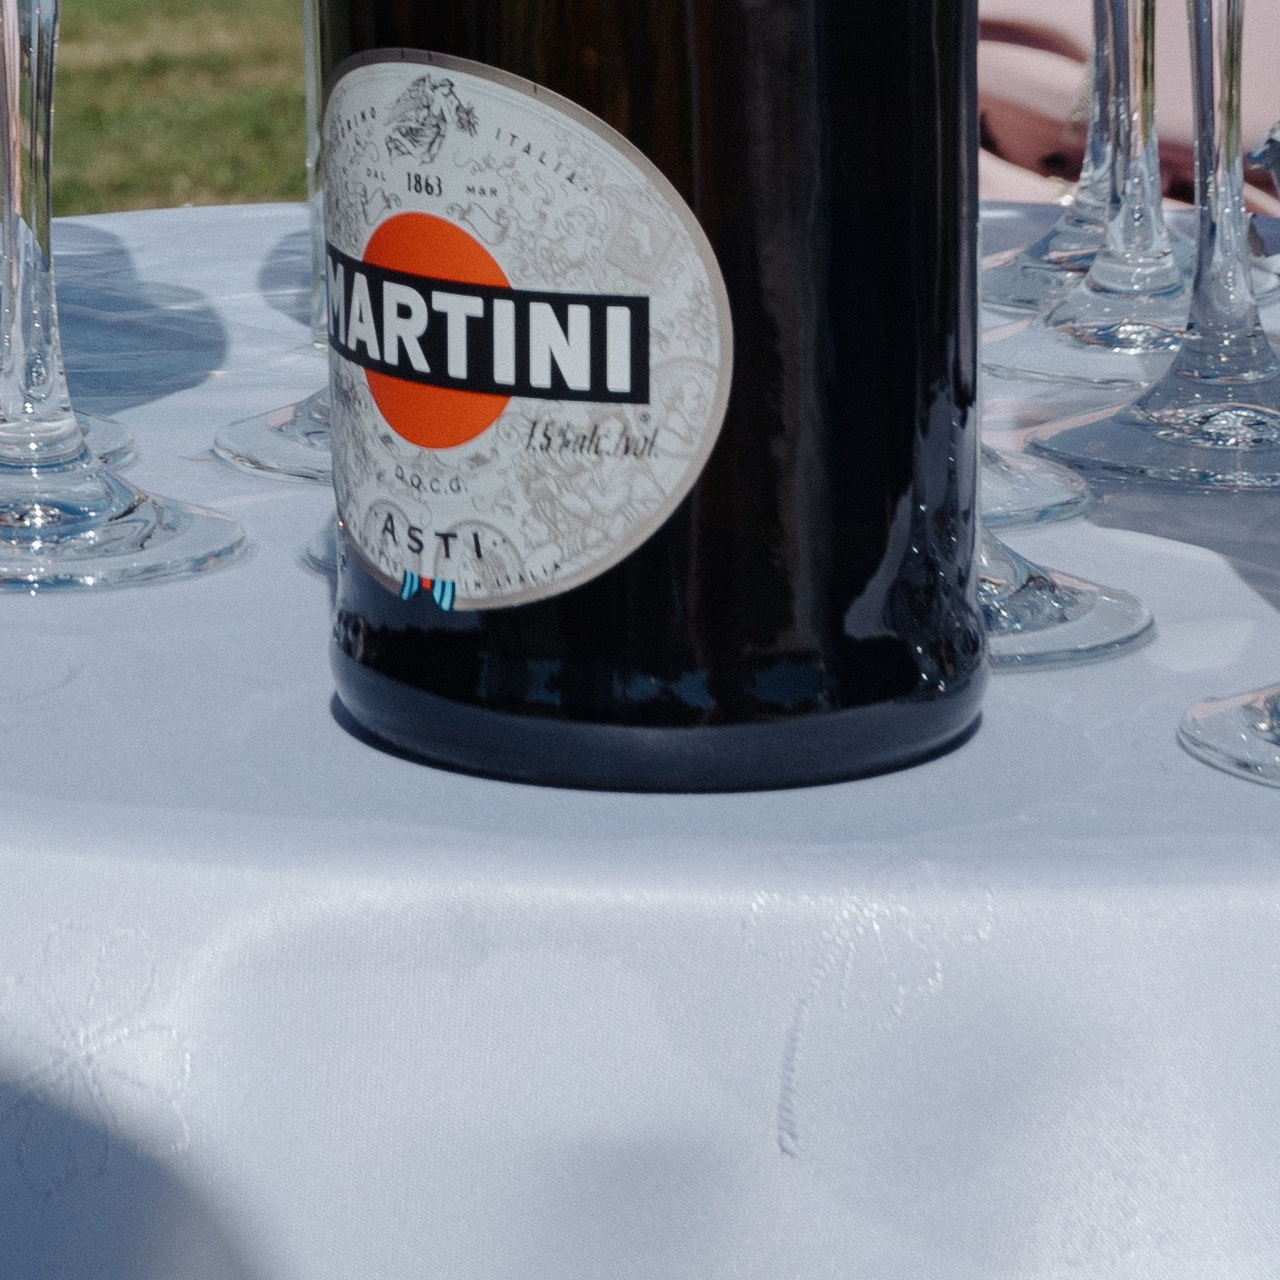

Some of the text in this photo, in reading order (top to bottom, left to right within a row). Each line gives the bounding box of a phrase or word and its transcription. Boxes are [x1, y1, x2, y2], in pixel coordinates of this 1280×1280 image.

[495, 128, 577, 184] ITALIA
[406, 171, 443, 198] 1863
[327, 254, 632, 394] MARTINI
[382, 512, 483, 560] ASTI
